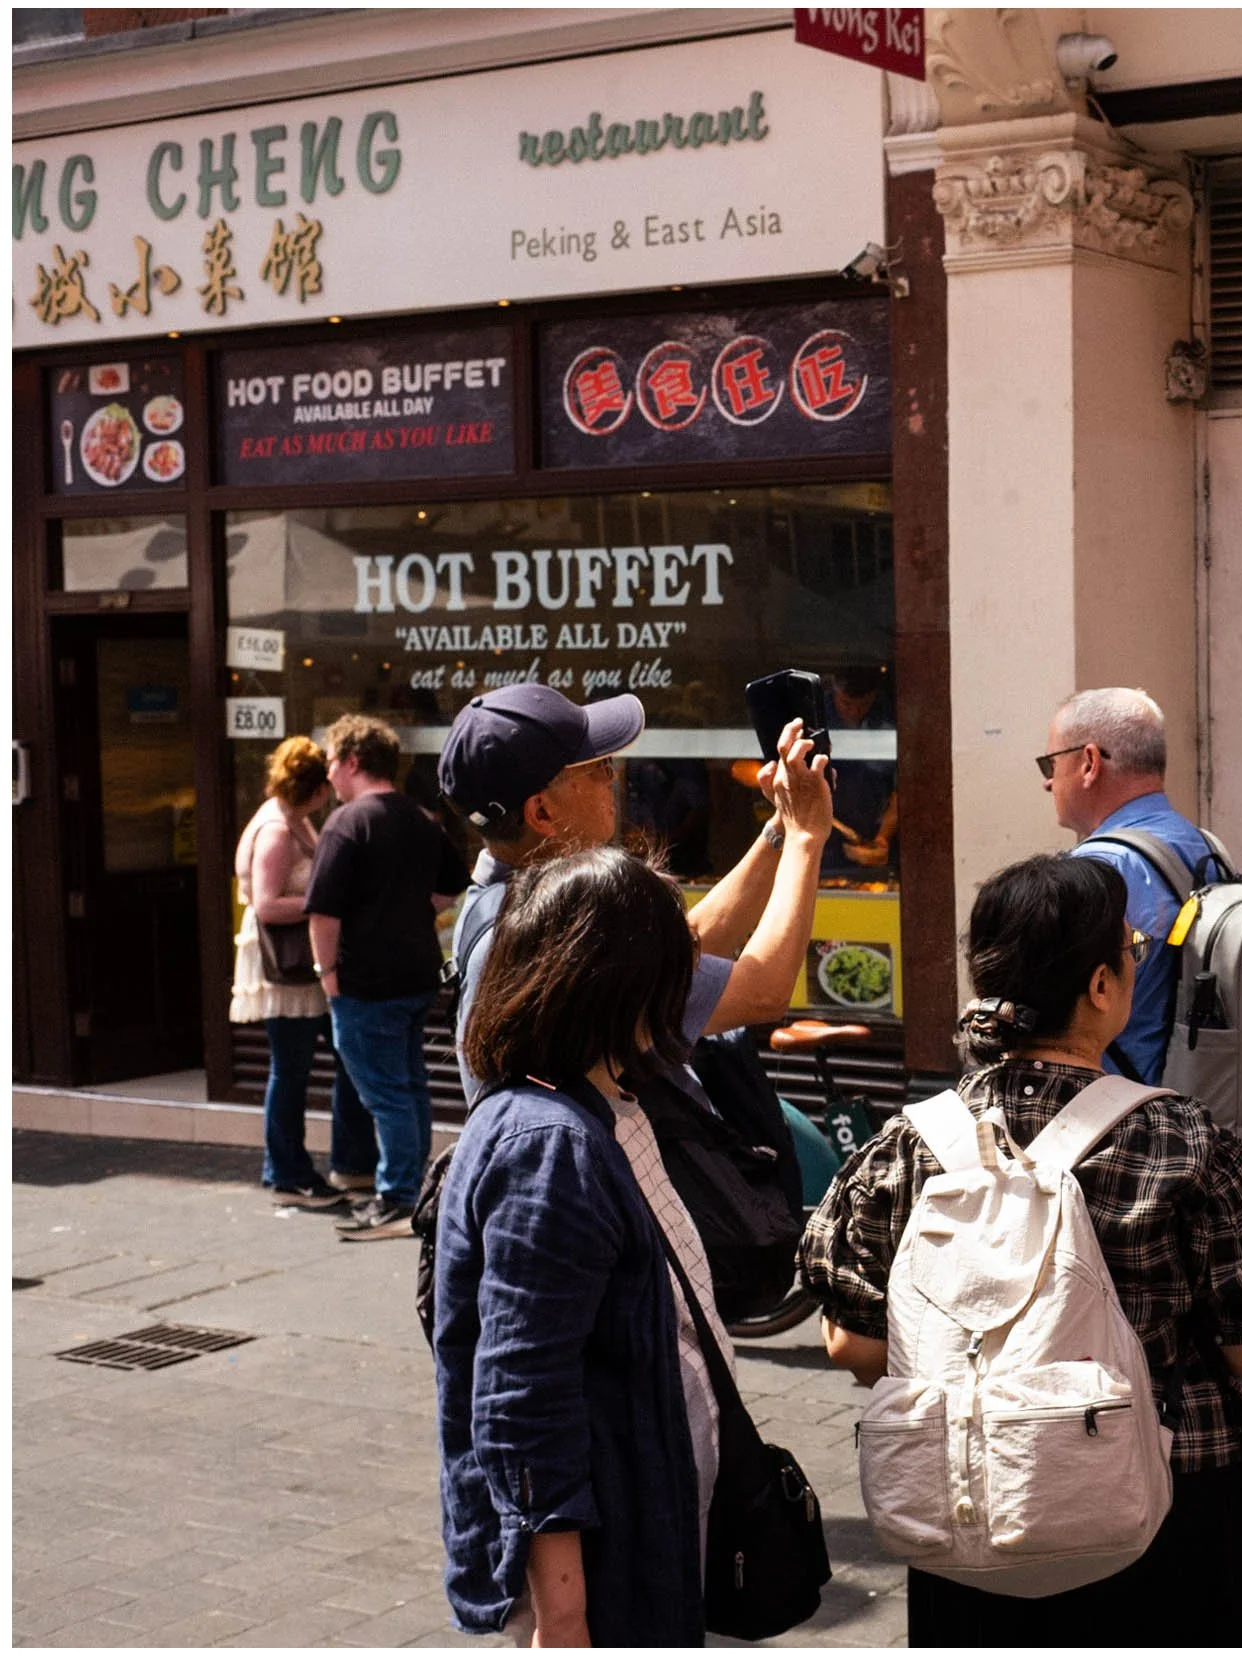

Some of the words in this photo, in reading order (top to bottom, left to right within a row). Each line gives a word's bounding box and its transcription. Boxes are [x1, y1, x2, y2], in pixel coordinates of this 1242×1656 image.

[885, 8, 920, 57] Kei
[519, 90, 770, 168] restaurant
[12, 154, 98, 240] NG
[146, 110, 402, 221] CHENG
[511, 225, 598, 262] Peking
[611, 219, 631, 250] &
[644, 215, 705, 247] East
[720, 205, 783, 240] Asia
[227, 375, 285, 407] HOT
[292, 368, 373, 401] FOOD
[381, 357, 506, 395] BUFFET
[576, 344, 857, 428] 美食任吃
[293, 400, 371, 424] AVAILABLE
[373, 399, 401, 419] ALL
[404, 396, 434, 416] DAY
[240, 436, 276, 458] EAT
[279, 435, 301, 456] AS
[306, 430, 368, 454] MUCH
[370, 429, 395, 450] AS
[400, 426, 439, 448] YOU
[445, 422, 495, 446] LIKE
[353, 552, 475, 614] HOT
[492, 543, 734, 610] BUFFET
[395, 624, 548, 651] “AVAILABLE
[555, 623, 611, 649] ALL
[617, 622, 687, 648] DAY”
[410, 664, 445, 689] eat
[451, 667, 477, 688] as
[484, 656, 540, 686] much
[548, 667, 574, 688] as
[582, 668, 622, 695] you
[629, 656, 673, 688] like
[235, 710, 277, 730] £8.00
